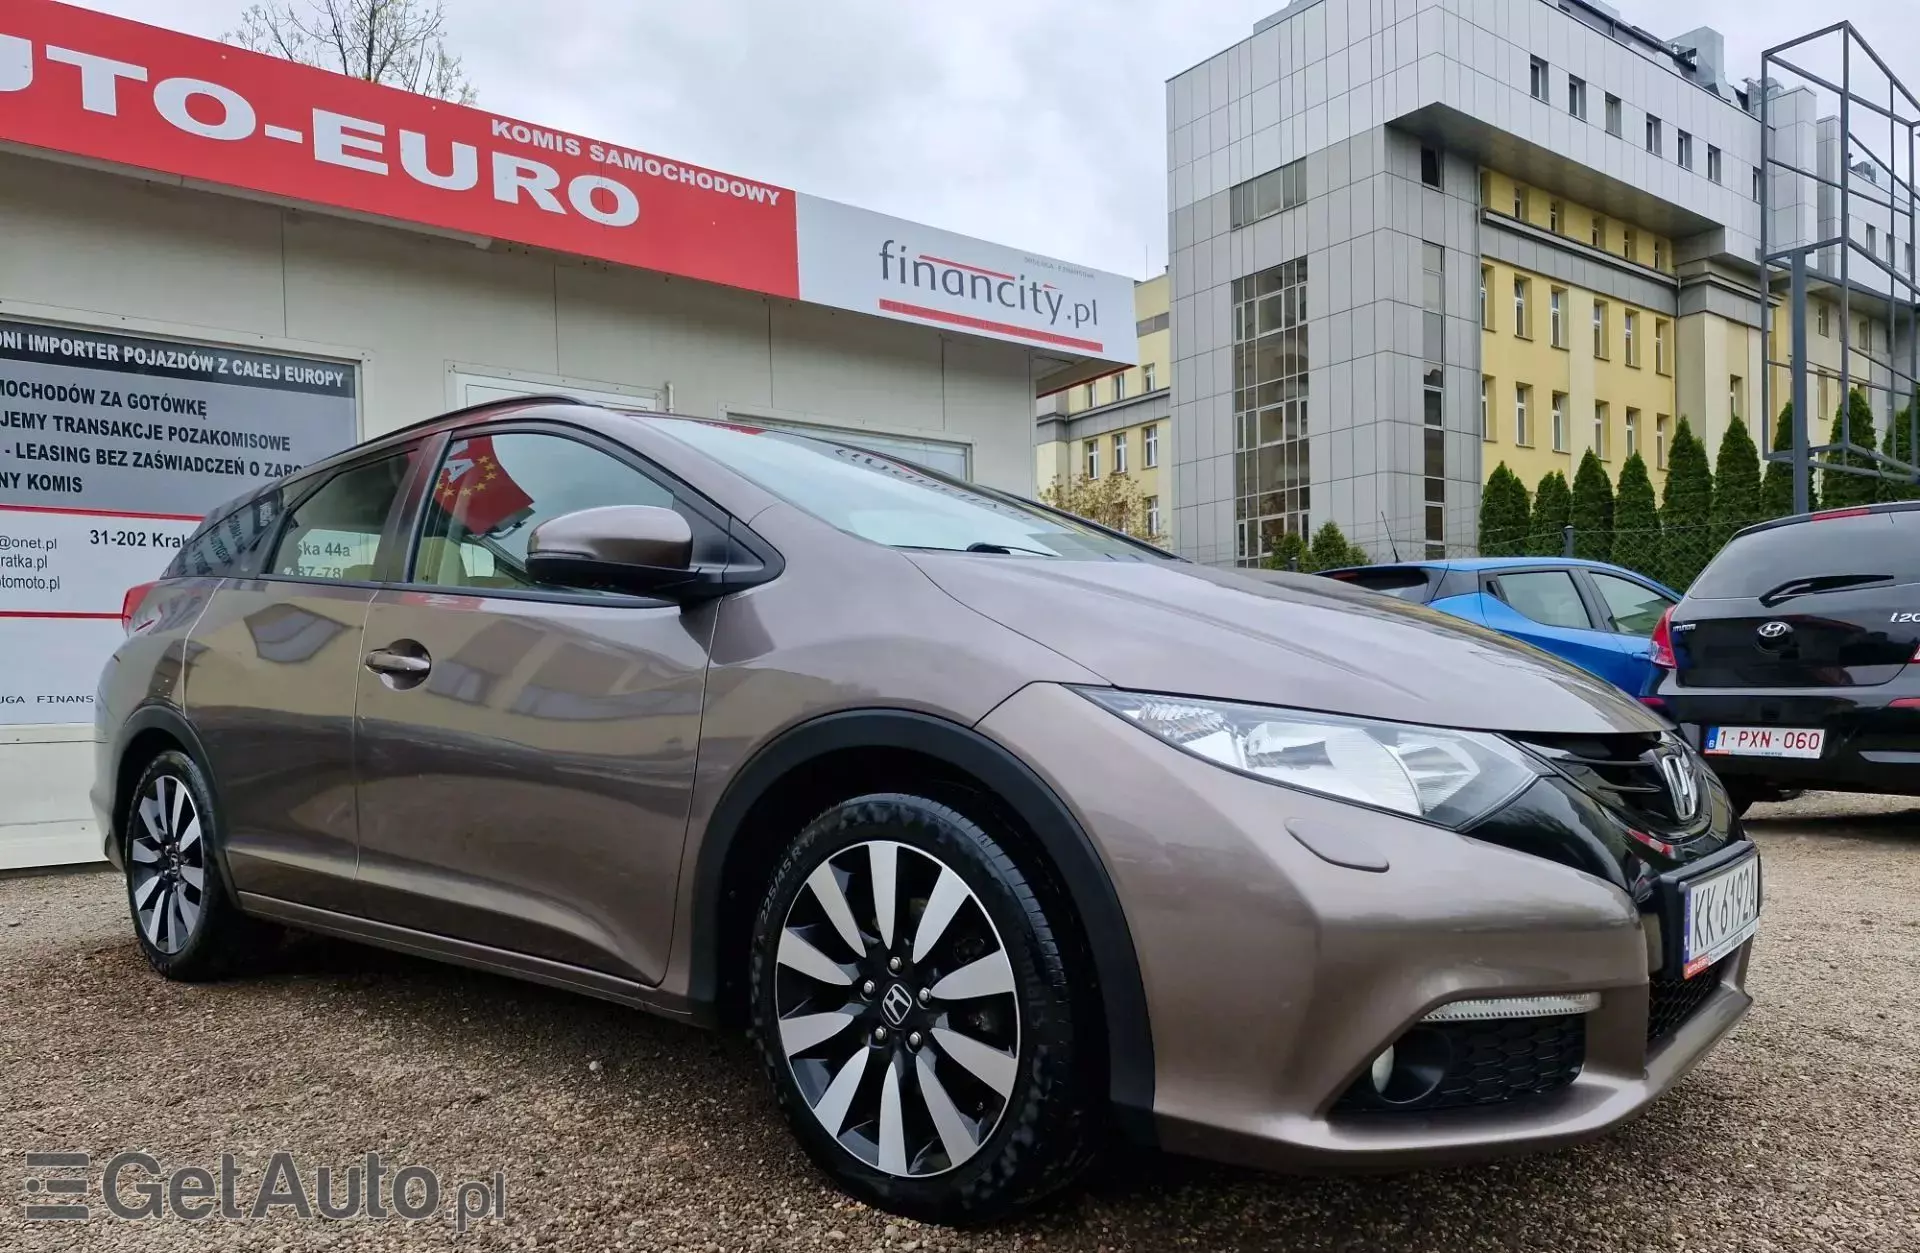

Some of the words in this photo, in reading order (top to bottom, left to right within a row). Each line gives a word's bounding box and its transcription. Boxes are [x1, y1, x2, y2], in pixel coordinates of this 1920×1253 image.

[492, 119, 581, 156] KOMIS
[589, 144, 780, 206] SAMOCHODOWY
[879, 239, 1098, 328] financity.pl
[28, 334, 119, 361] IMPORTER
[124, 346, 213, 372] POJAZDÓW
[218, 358, 228, 374] Z
[232, 359, 280, 379] CAŁEJ
[285, 365, 343, 387] EUROPY
[100, 390, 122, 408] ZA
[127, 393, 207, 420] GOTÓWKĘ
[53, 415, 163, 441] TRANSAKCJE
[168, 425, 291, 452] POZAKOMISOWE
[16, 442, 91, 464] LEASING
[96, 448, 128, 467] BEZ
[133, 450, 245, 476] ZAŚWIADCZEŃ
[250, 461, 260, 477] O
[27, 473, 83, 493] KOMIS
[90, 529, 147, 547] 31-202
[325, 542, 352, 557] 44a
[0, 573, 61, 592] tomoto.pl
[37, 695, 95, 704] FINANS
[1694, 885, 1717, 953] KK
[1720, 862, 1757, 936] 6192A
